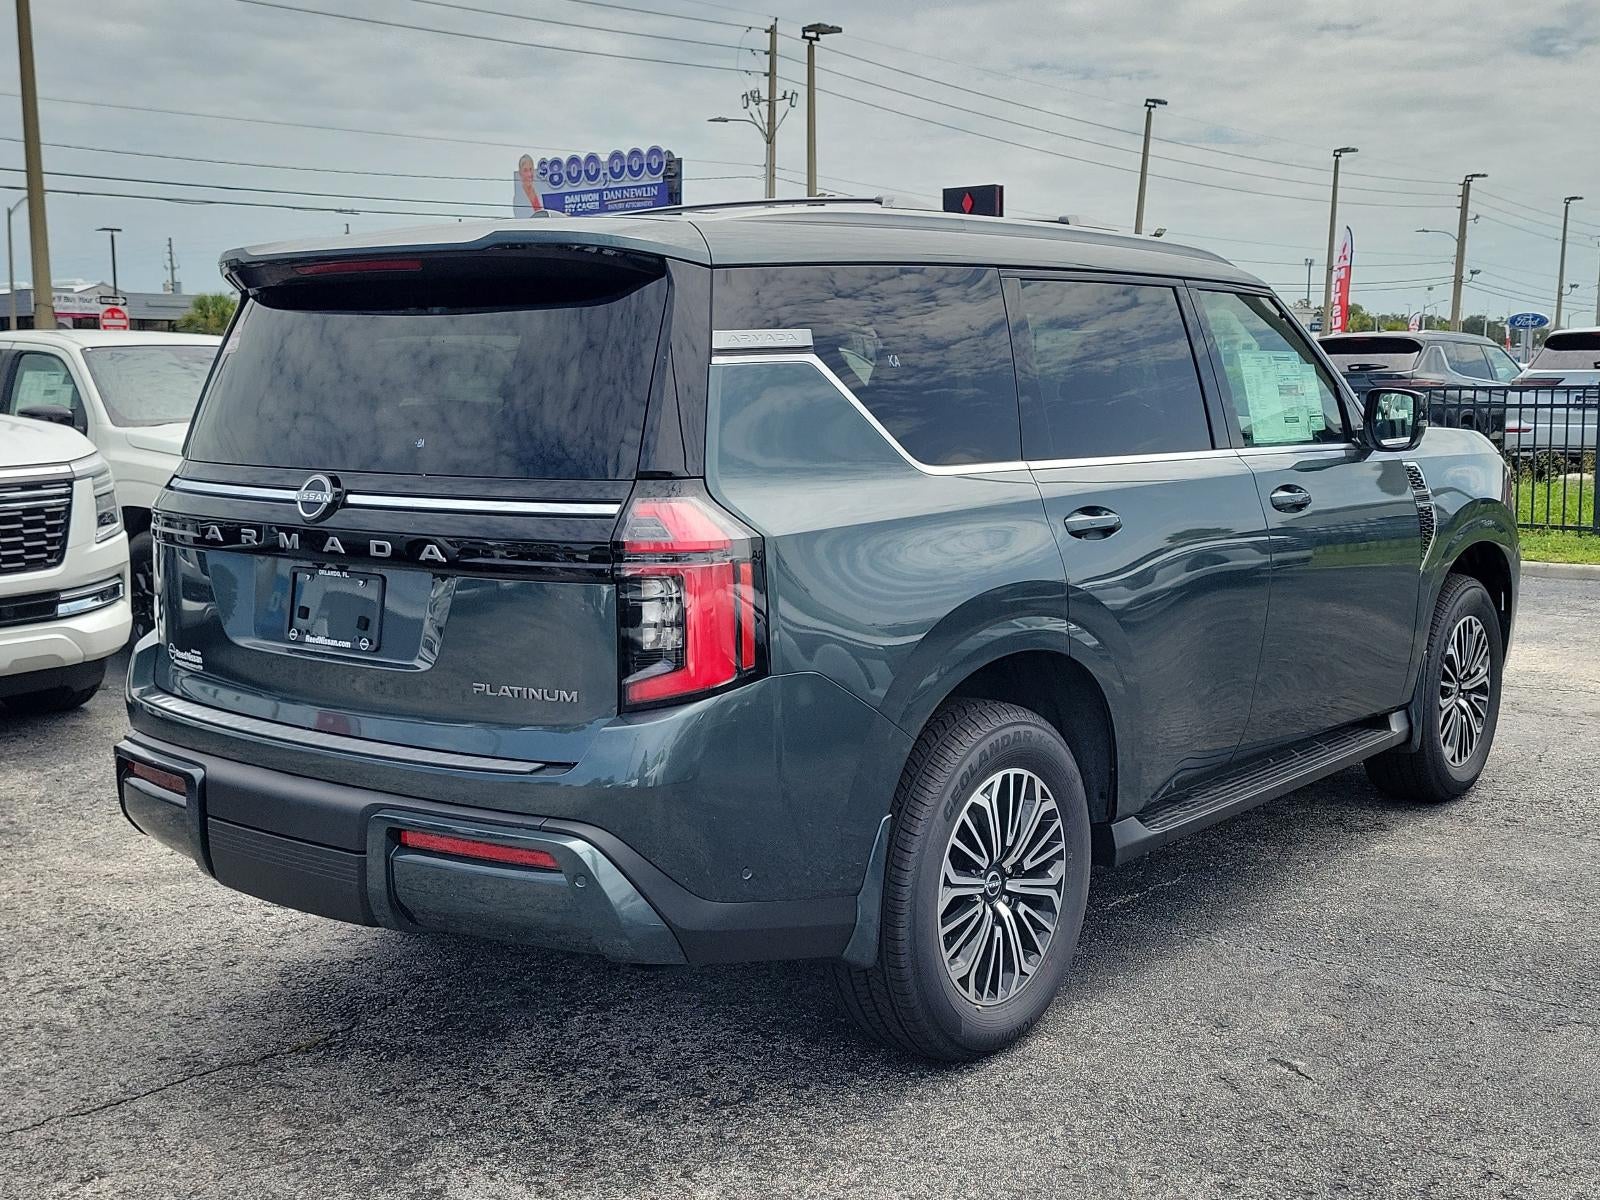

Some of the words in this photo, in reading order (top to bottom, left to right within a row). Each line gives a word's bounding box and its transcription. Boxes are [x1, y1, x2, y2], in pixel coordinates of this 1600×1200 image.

[537, 145, 667, 190] $800,000
[564, 194, 581, 204] DAN
[581, 192, 600, 202] WON
[603, 190, 621, 201] DAN
[622, 186, 658, 198] NEWLIN
[1514, 314, 1541, 327] Ford
[728, 333, 800, 345] ARMADA
[296, 491, 332, 503] NISSAN
[205, 524, 447, 563] ARMADA
[305, 634, 351, 649] ReedNissan.com
[472, 682, 578, 703] PLATINUM
